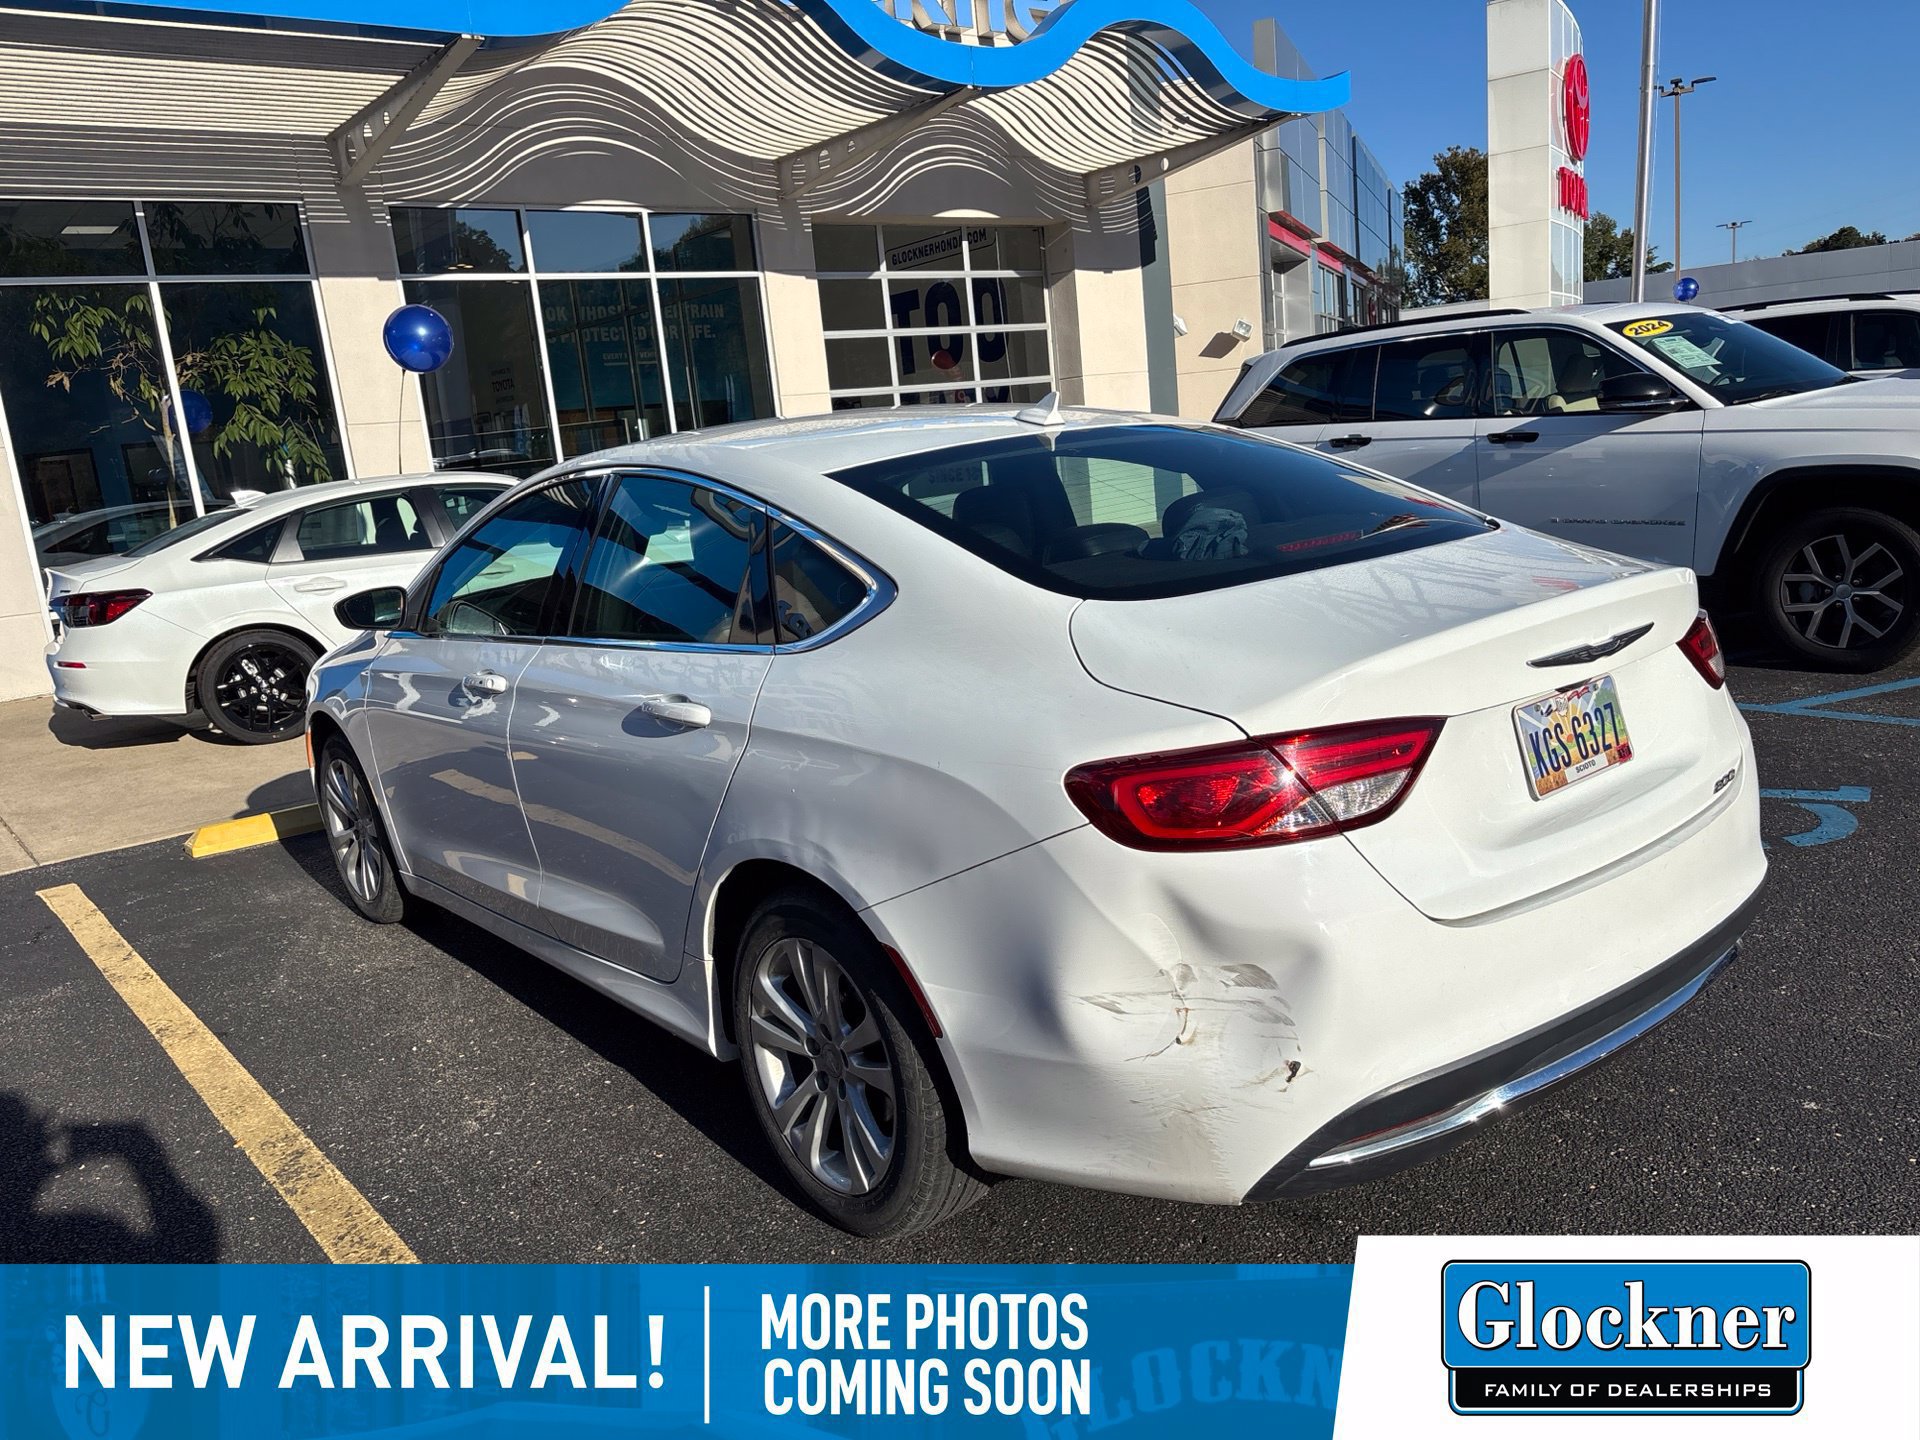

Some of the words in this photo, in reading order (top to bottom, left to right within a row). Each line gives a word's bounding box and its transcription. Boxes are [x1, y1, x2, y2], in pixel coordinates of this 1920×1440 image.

[891, 228, 987, 266] GLOCKNERHONDACOM
[1628, 320, 1669, 336] 2024
[1529, 723, 1571, 778] KGS
[1572, 702, 1619, 760] 6327
